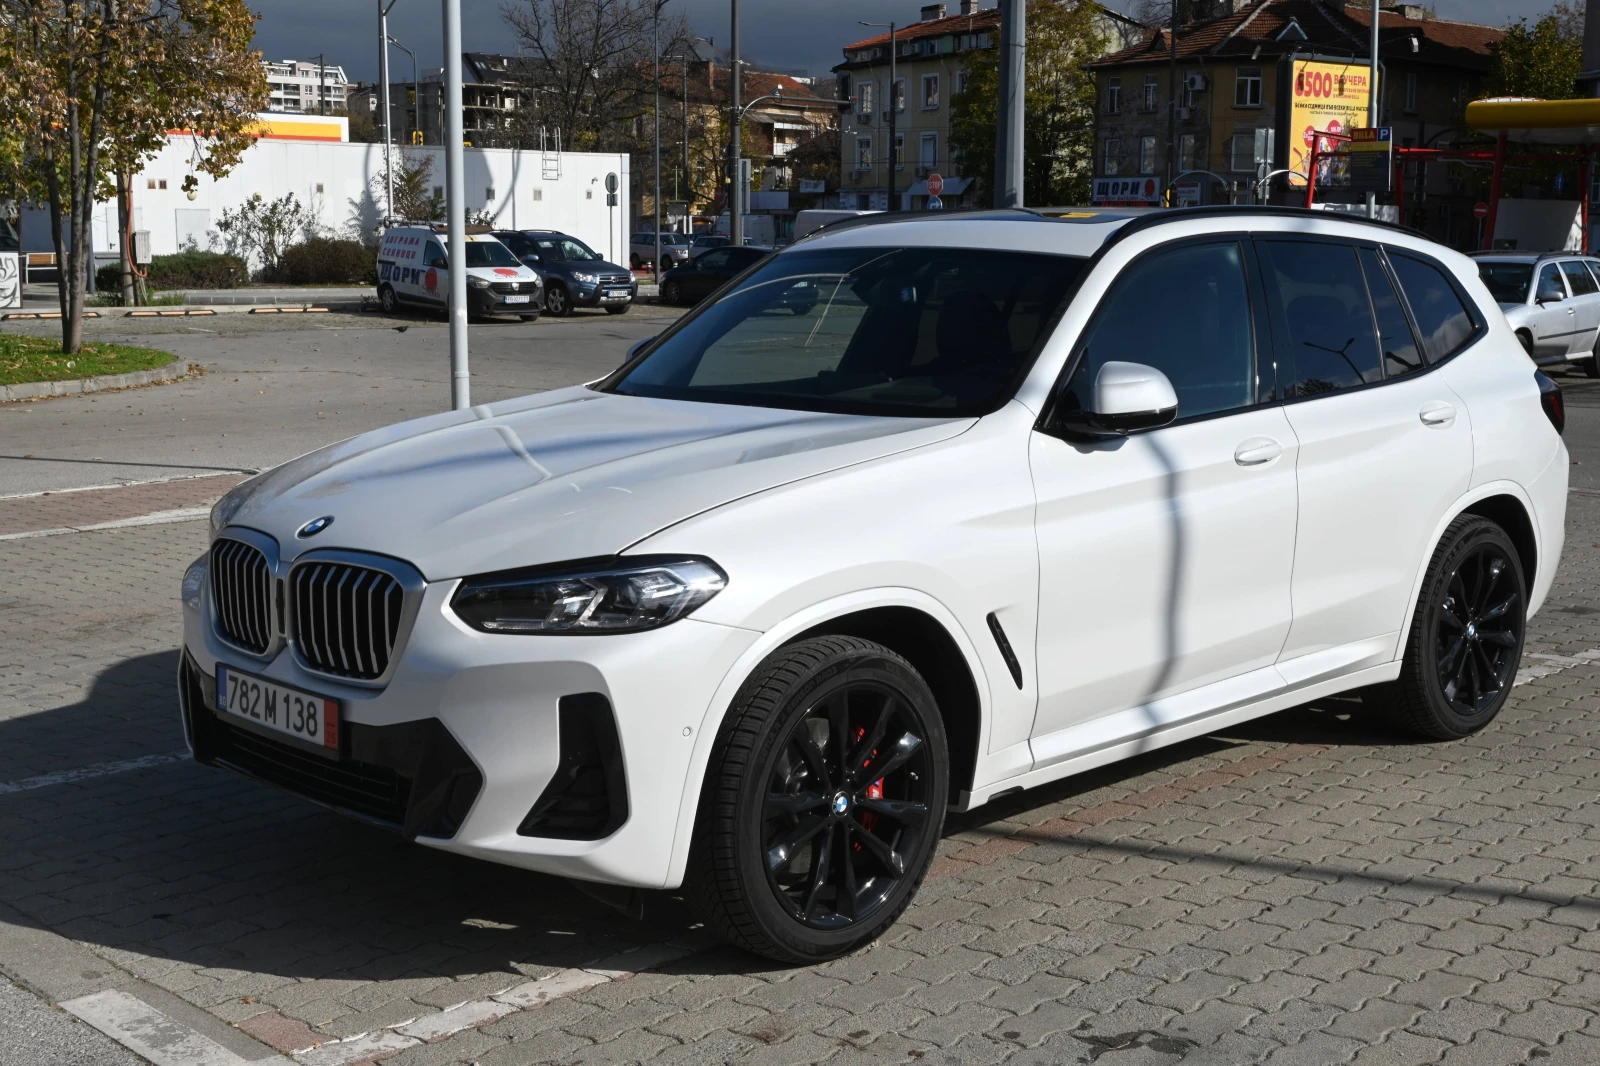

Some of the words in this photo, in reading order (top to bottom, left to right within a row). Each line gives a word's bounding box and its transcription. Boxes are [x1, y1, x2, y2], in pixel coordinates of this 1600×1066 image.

[1334, 74, 1367, 86] ВУЧЕРА
[1353, 131, 1375, 140] BILLA
[1380, 129, 1389, 140] P
[928, 181, 941, 190] STOP
[1096, 181, 1141, 196] ЩОРИ
[384, 235, 420, 246] ДОГРАМА
[380, 264, 421, 285] ЩОРИ
[219, 694, 227, 706] BG
[228, 674, 261, 720] 782
[264, 687, 277, 725] M
[283, 693, 318, 737] 138
